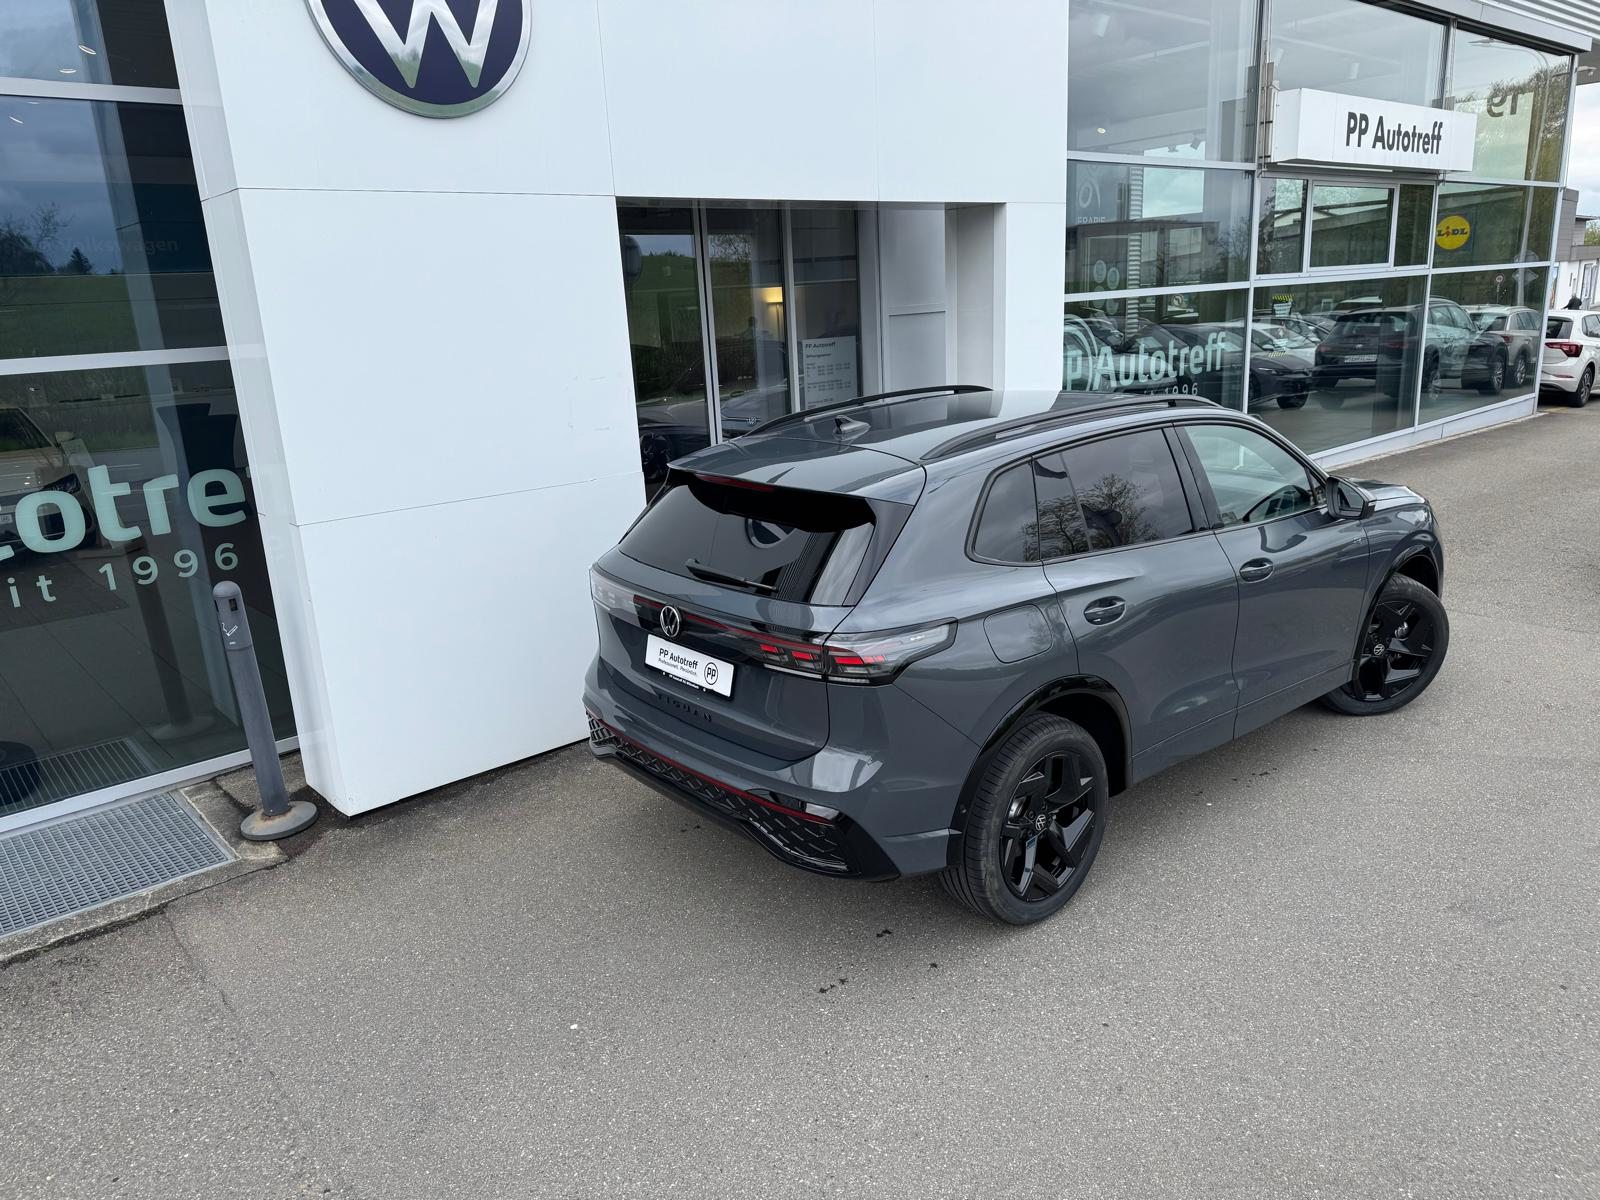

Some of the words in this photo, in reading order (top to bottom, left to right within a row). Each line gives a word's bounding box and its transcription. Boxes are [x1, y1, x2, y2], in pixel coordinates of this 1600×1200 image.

[1346, 111, 1369, 148] PP
[1372, 115, 1443, 155] Autotreff
[1093, 331, 1226, 390] Autotreff
[0, 464, 249, 562] otre
[99, 543, 239, 591] 1996
[659, 648, 669, 658] PP
[669, 652, 698, 670] Autotreff
[706, 668, 717, 680] PP
